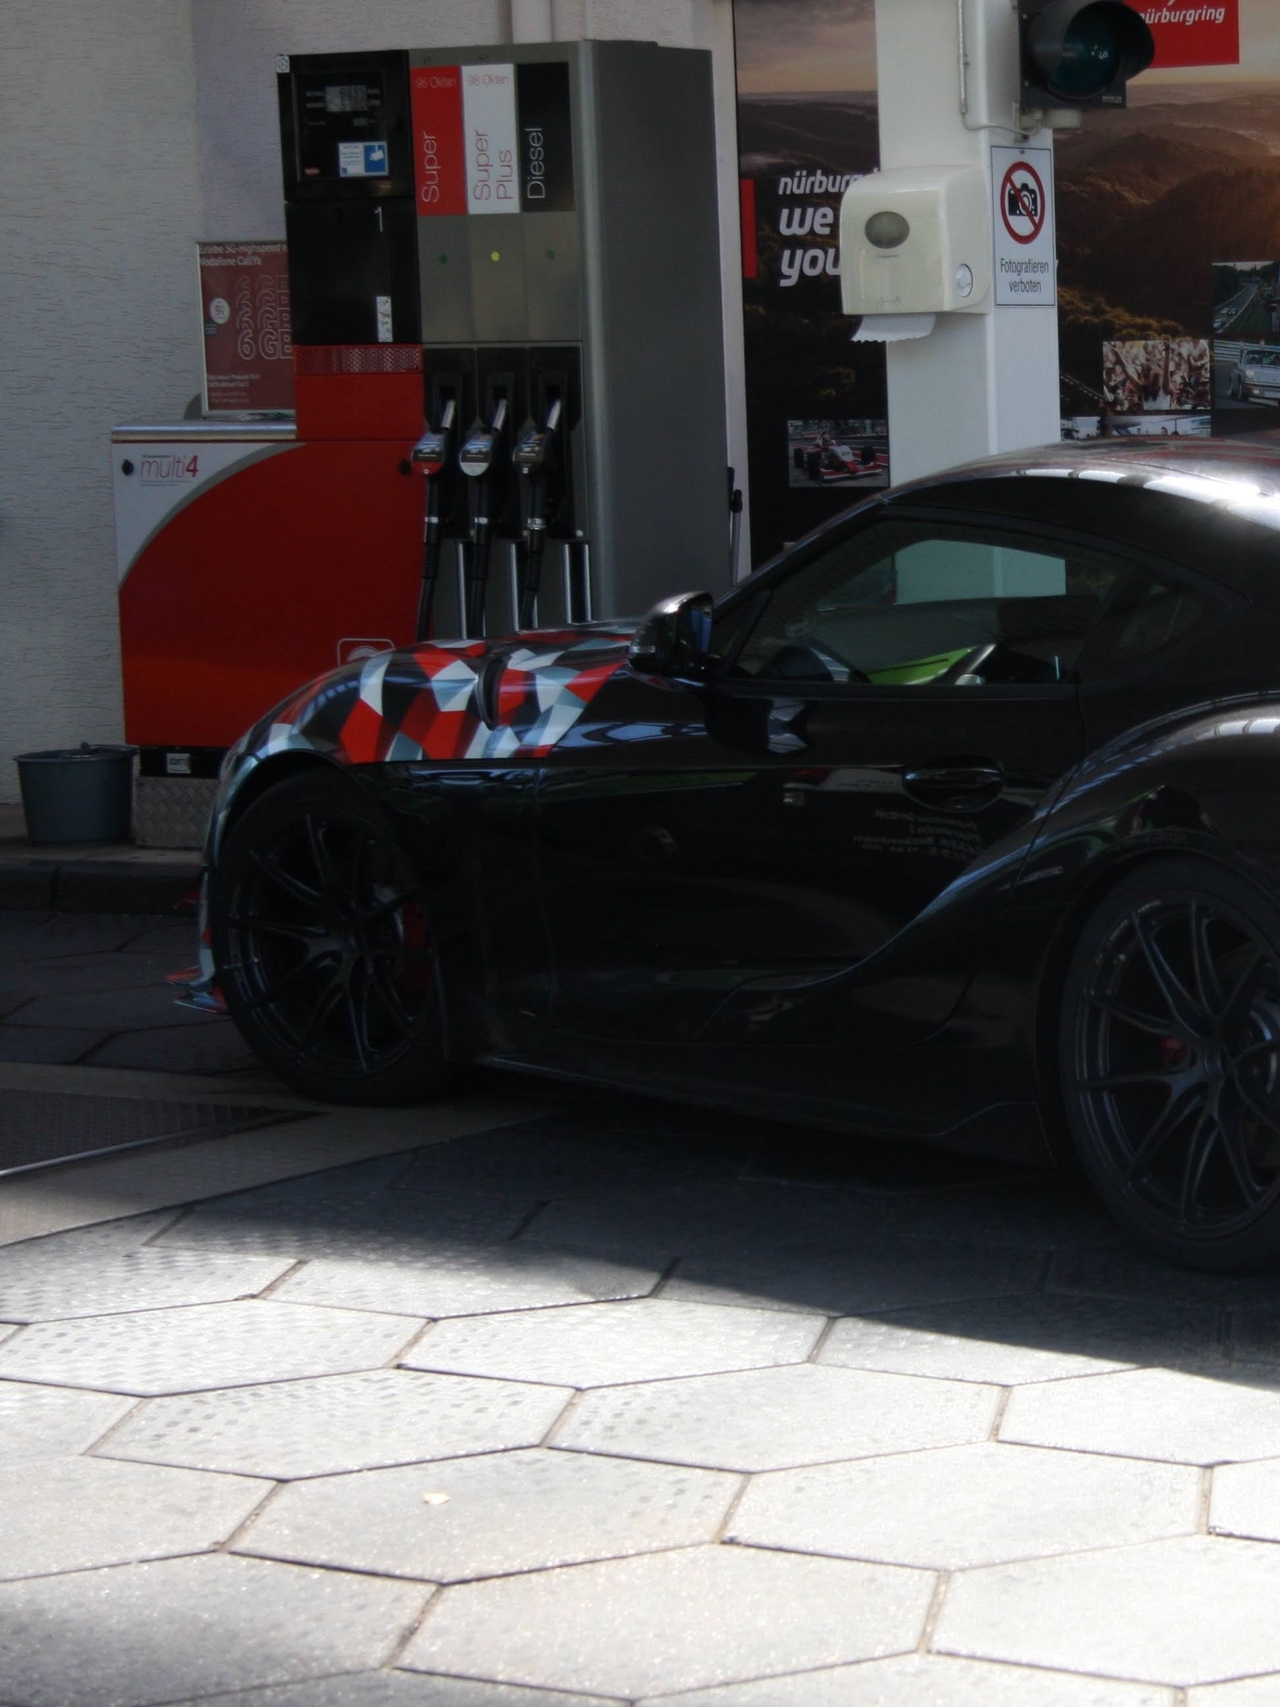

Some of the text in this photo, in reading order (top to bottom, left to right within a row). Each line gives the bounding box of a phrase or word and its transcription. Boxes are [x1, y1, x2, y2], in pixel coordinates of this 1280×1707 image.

[430, 76, 457, 88] Oktan
[482, 74, 509, 85] Oktan
[421, 130, 442, 203] Super
[473, 129, 494, 201] Super
[496, 150, 514, 200] Plus
[524, 127, 546, 199] Diesel
[373, 205, 383, 233] 1
[779, 206, 834, 236] we
[200, 256, 236, 267] Vodafone
[1000, 258, 1049, 276] Fotografieren
[1008, 279, 1042, 293] verboten
